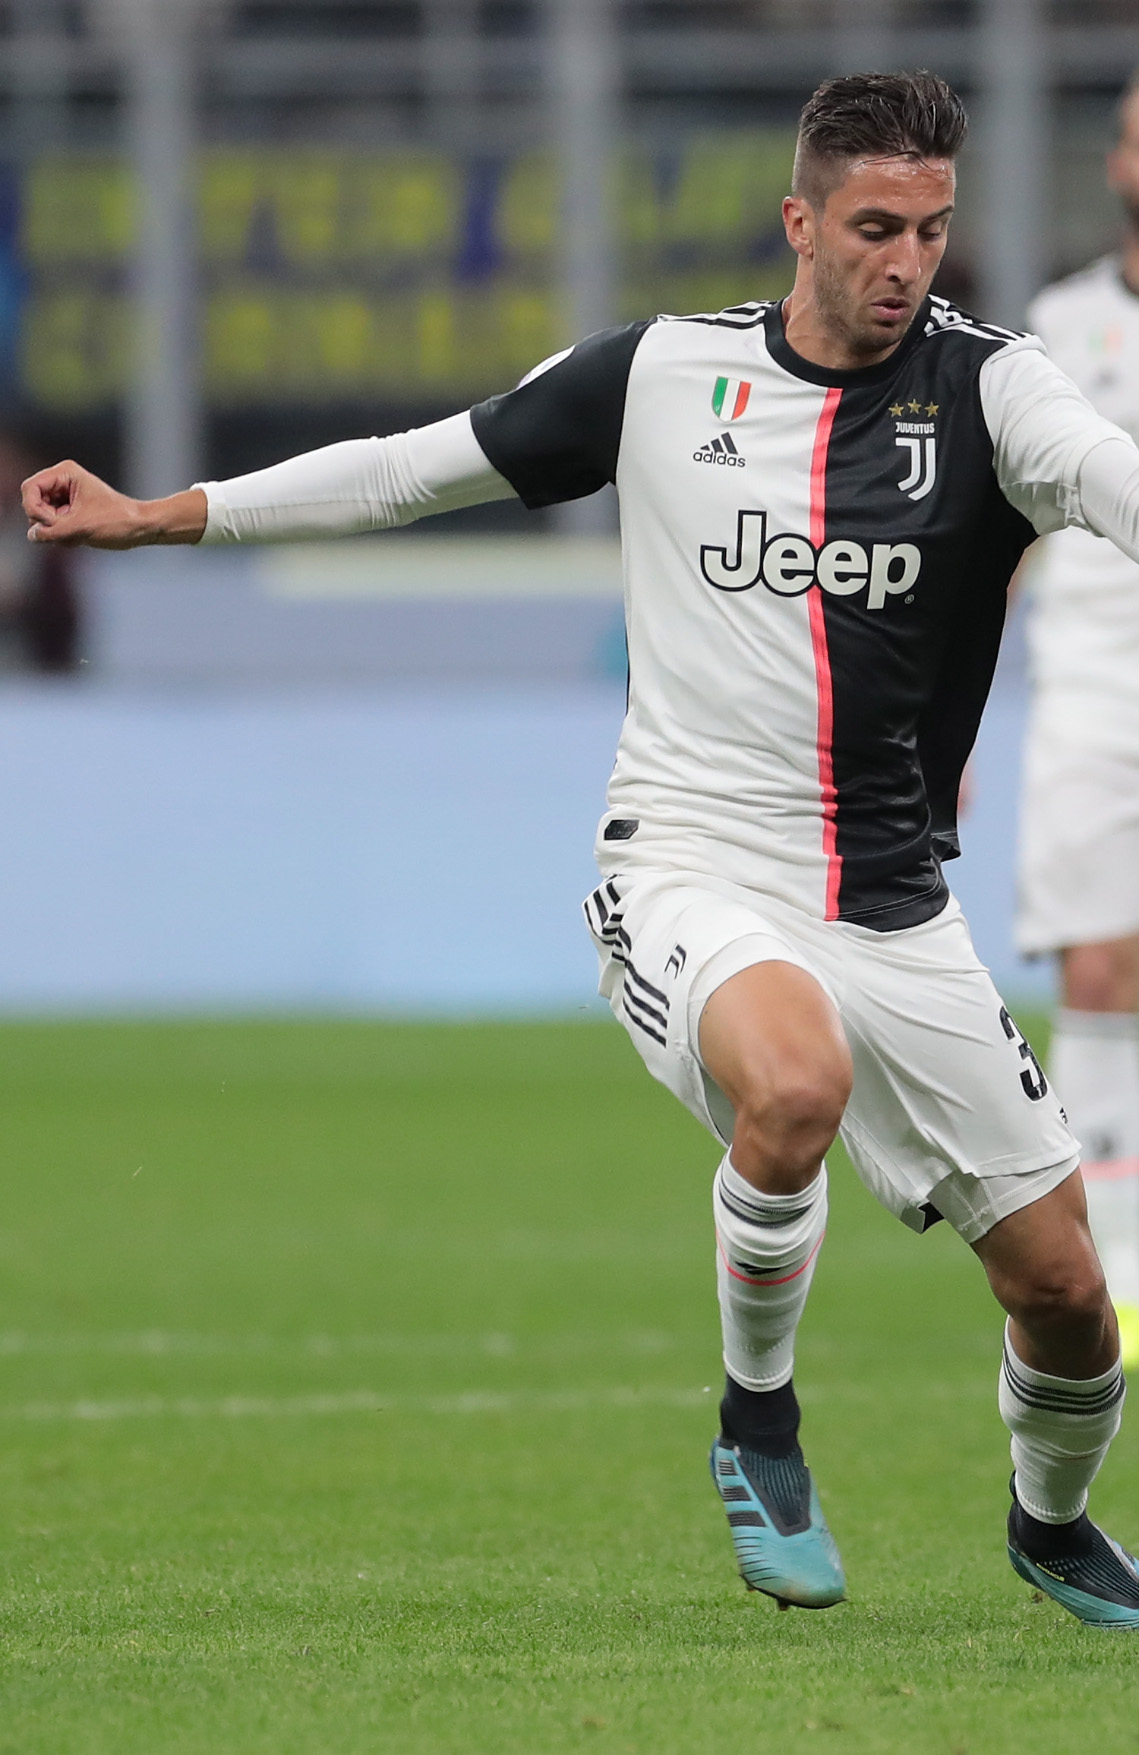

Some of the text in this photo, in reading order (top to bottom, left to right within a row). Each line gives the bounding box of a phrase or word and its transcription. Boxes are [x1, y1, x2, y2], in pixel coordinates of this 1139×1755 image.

[894, 421, 936, 435] JUVENTUS
[692, 451, 747, 468] adidas
[700, 510, 922, 610] Jeep
